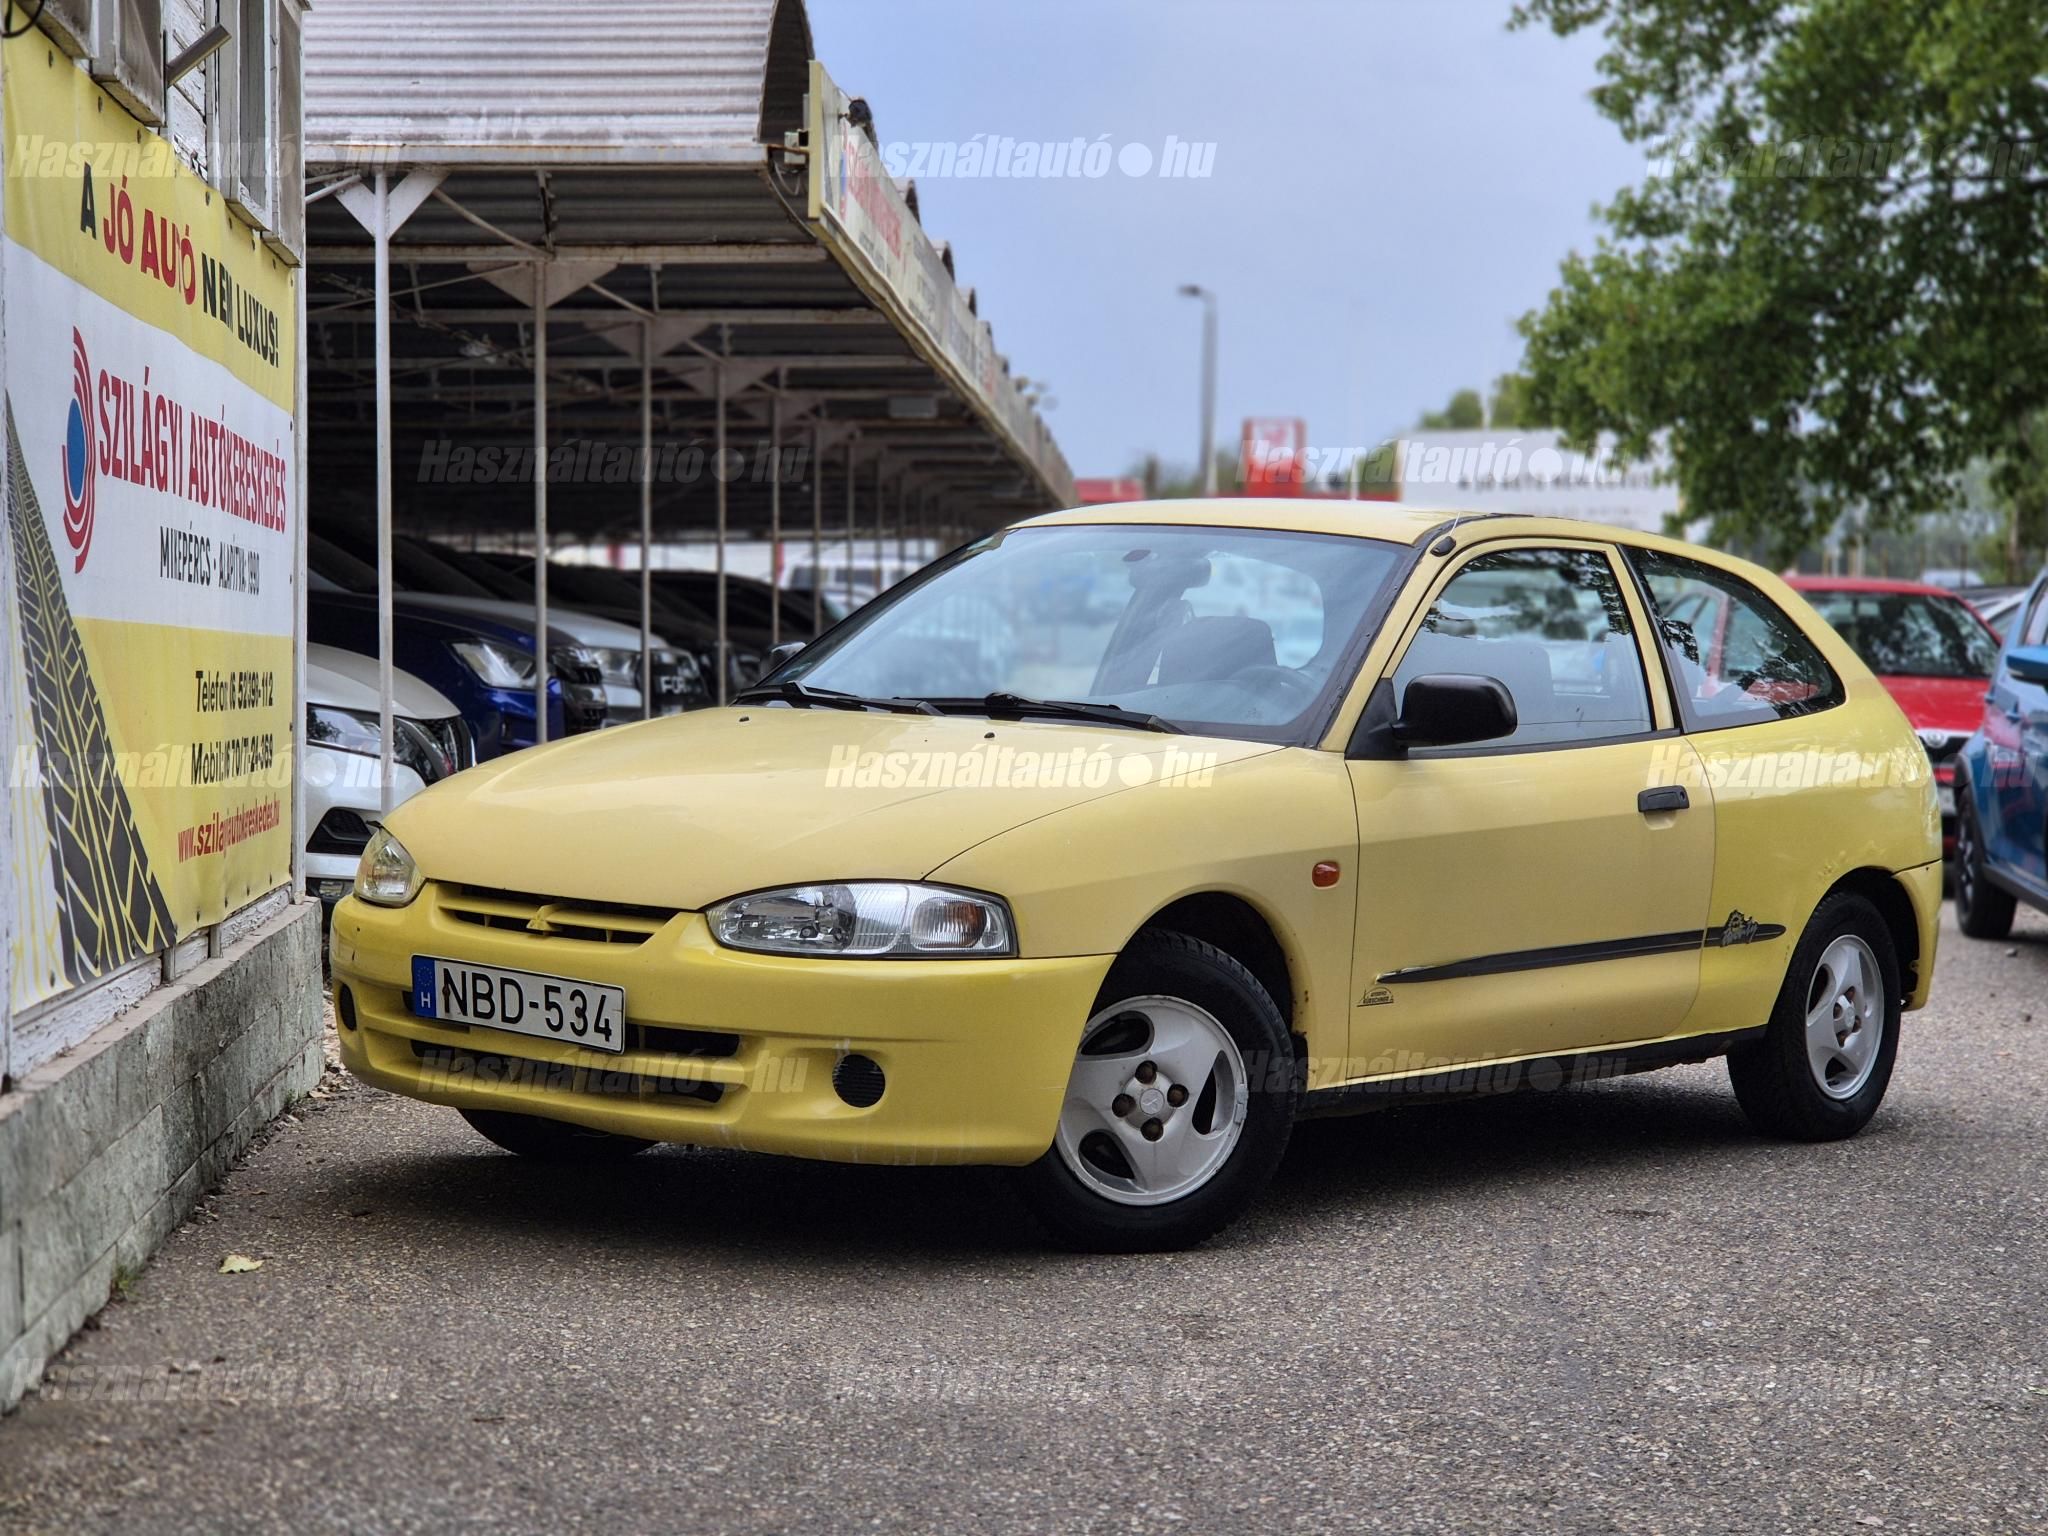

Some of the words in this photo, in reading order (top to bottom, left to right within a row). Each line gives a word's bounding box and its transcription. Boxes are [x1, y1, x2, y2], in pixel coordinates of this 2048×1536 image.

[80, 161, 97, 240] A
[103, 174, 134, 264] JÓ
[236, 283, 279, 368] LUXUS!
[98, 366, 183, 498] SZILÁGYI
[187, 404, 286, 534] AUTÓKERESKEDÉS
[420, 991, 431, 1009] H
[441, 967, 613, 1043] NBD-534
